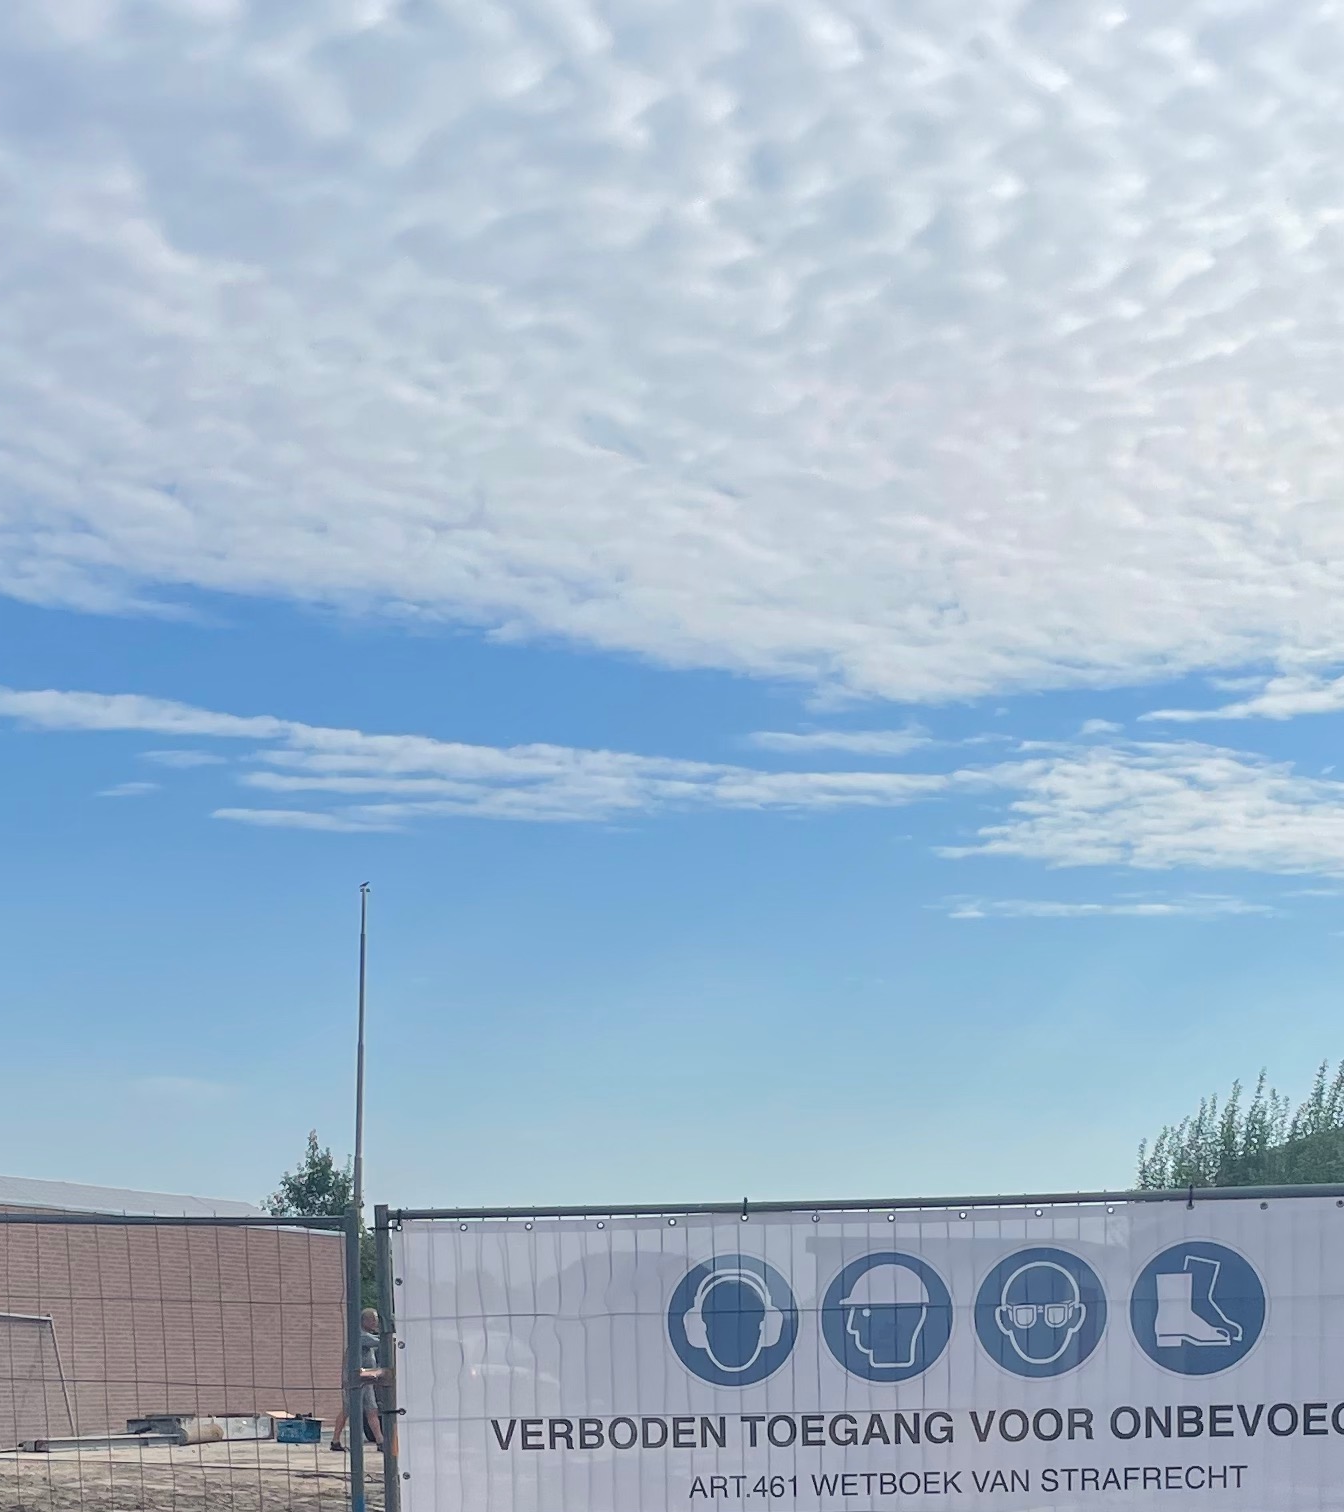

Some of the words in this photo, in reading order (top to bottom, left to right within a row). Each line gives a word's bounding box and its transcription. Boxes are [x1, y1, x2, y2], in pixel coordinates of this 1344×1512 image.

[491, 1416, 726, 1450] VERBODEN
[741, 1410, 954, 1448] TOEGANG
[970, 1406, 1094, 1443] VOOR
[689, 1475, 799, 1499] ART.461
[812, 1471, 962, 1497] WETBOEK
[971, 1469, 1031, 1494] VAN
[1040, 1465, 1249, 1493] STRAFRECHT
